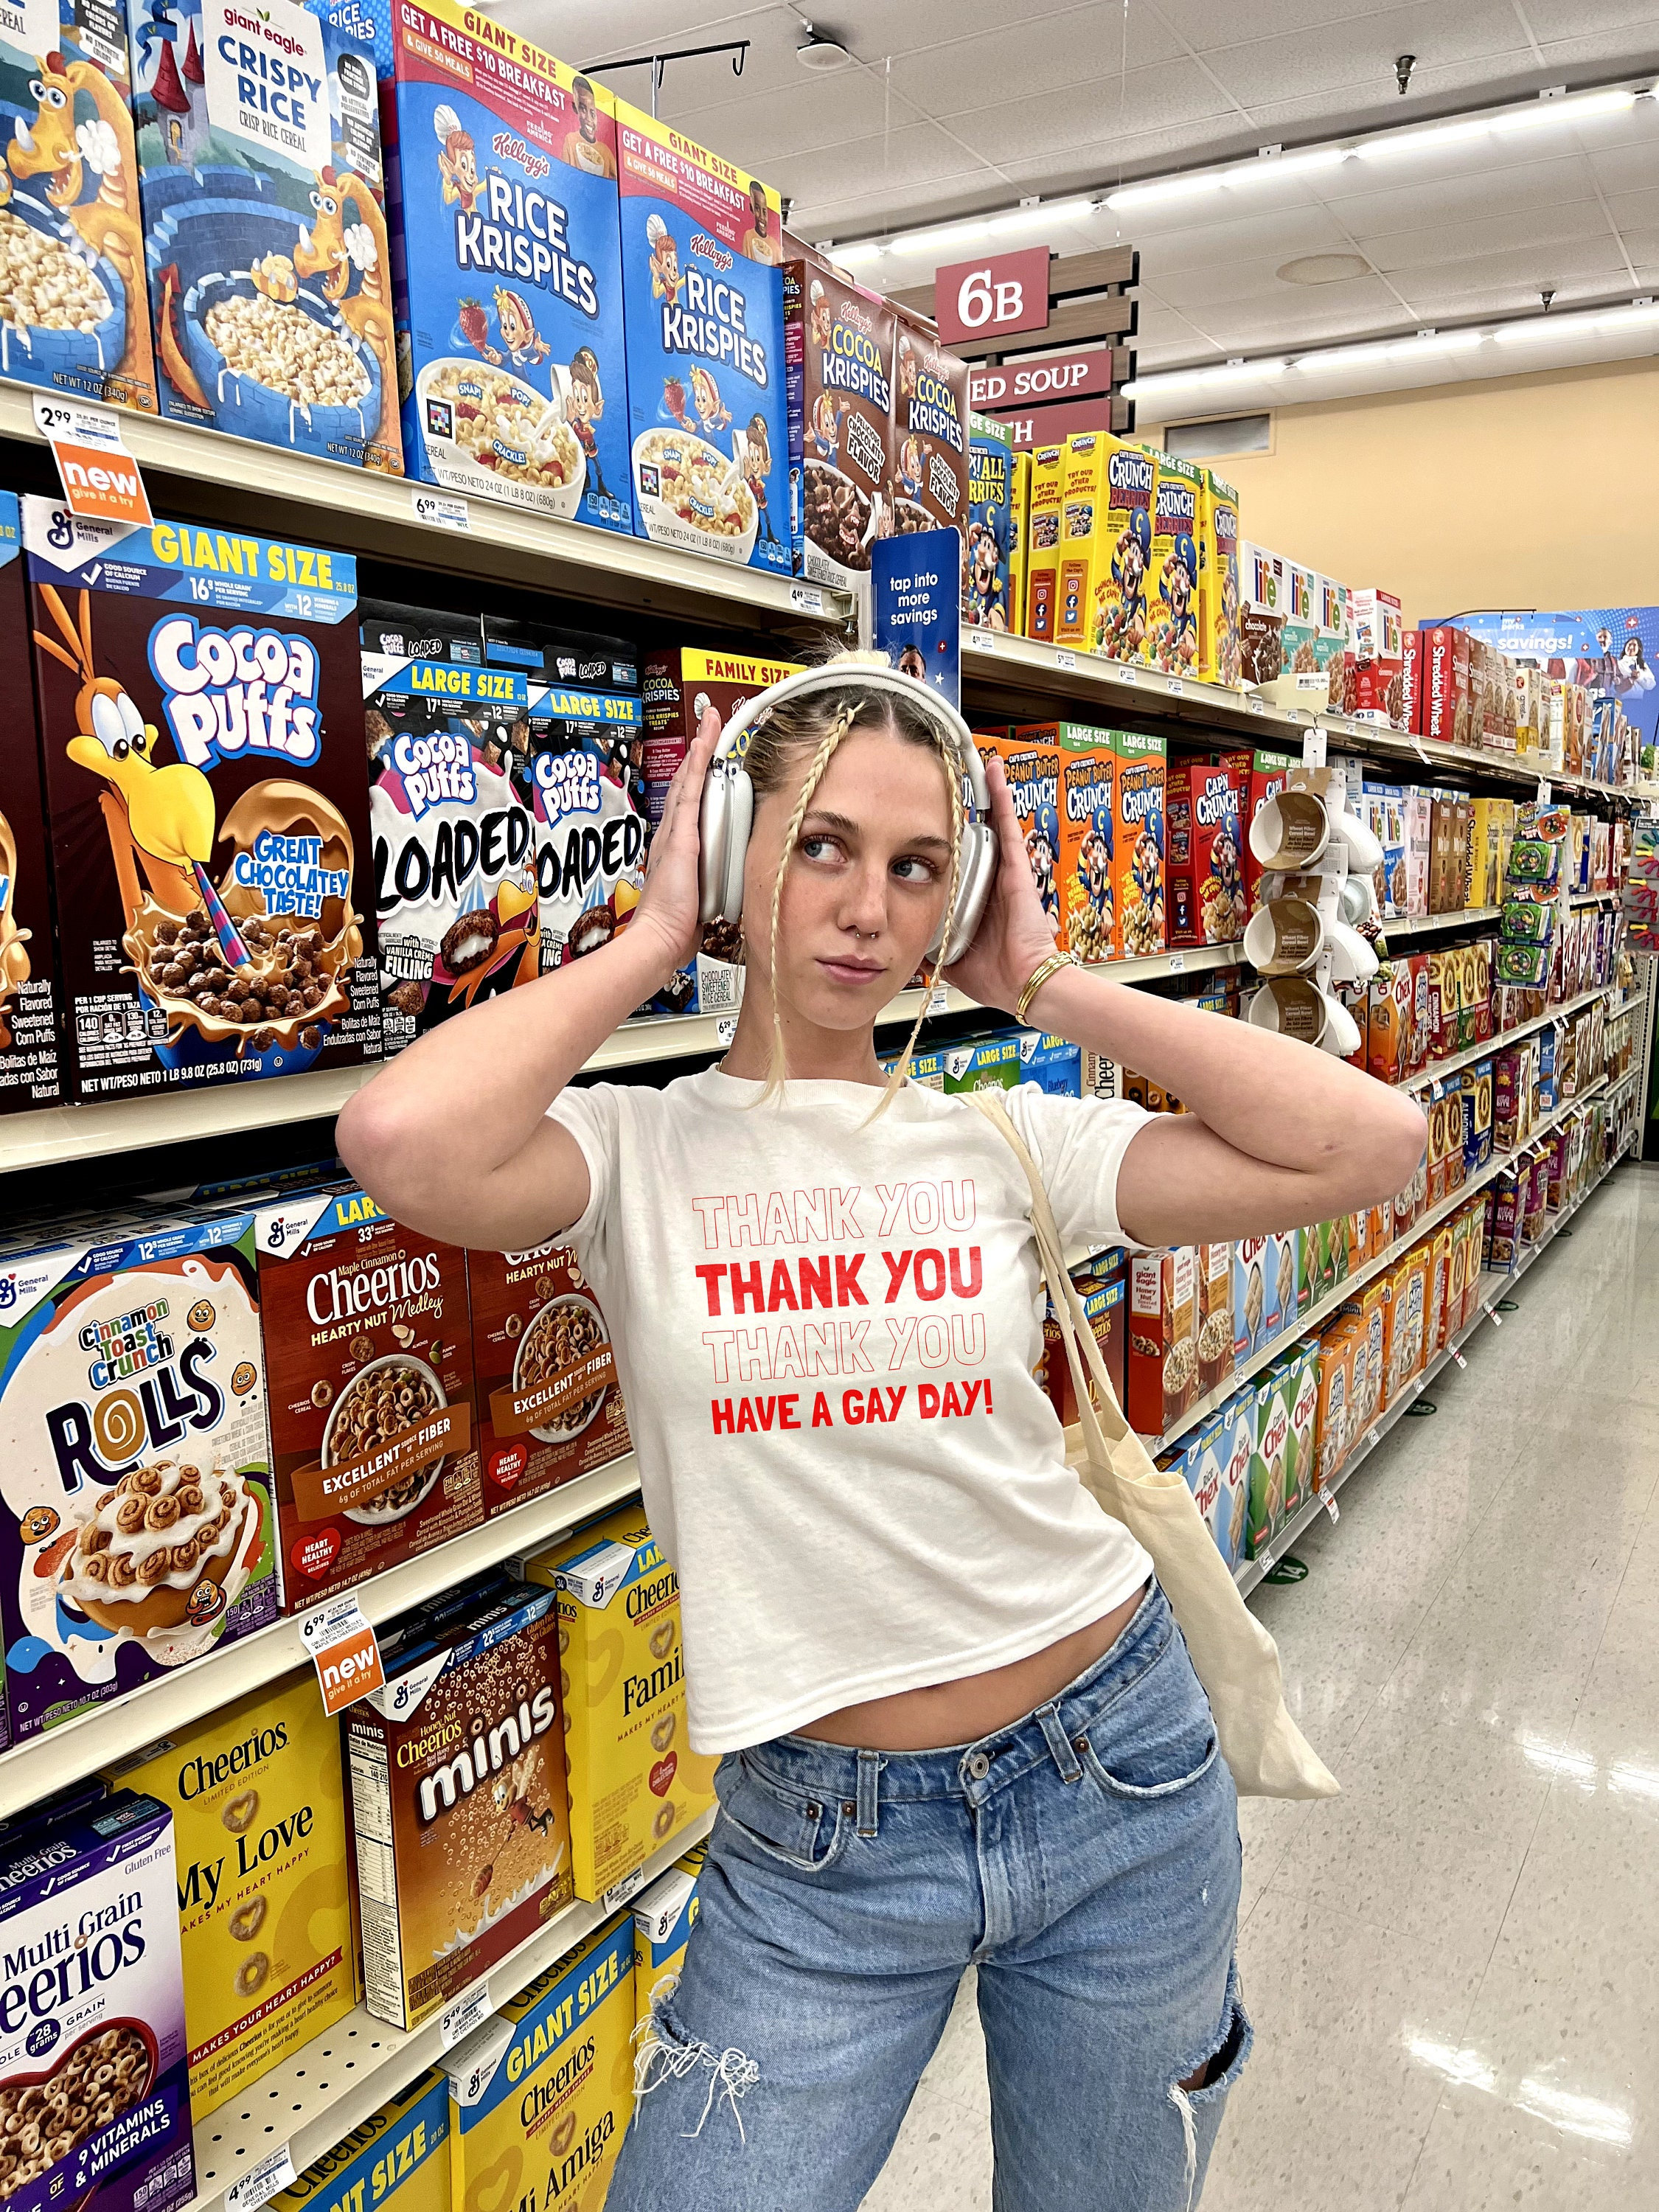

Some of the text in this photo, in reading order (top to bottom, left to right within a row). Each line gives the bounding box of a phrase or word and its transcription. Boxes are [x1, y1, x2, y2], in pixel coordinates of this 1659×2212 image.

[224, 8, 305, 56] giant eagle
[465, 11, 556, 79] GIANT SIZE
[218, 35, 321, 102] CRISPY
[401, 4, 425, 34] GET
[441, 26, 473, 60] FREE
[476, 46, 495, 72] $10
[498, 60, 565, 111] BREAKFAST
[445, 55, 470, 77] MEALS
[238, 74, 306, 130] RICE
[281, 129, 307, 153] CEREAL
[493, 133, 550, 179] Kellogg's
[696, 171, 745, 212] BREAKFAST
[490, 178, 567, 252] RICE
[456, 215, 599, 318] KRISPIES
[687, 272, 745, 332] RICE
[958, 269, 1023, 328] 6B
[663, 307, 768, 389] KRISPIES
[832, 324, 883, 375] COCOA
[53, 372, 68, 385] NET
[69, 377, 81, 388] WT
[83, 380, 92, 391] 12
[94, 383, 103, 394] OZ
[104, 386, 127, 403] (340g)
[823, 352, 890, 413] KRISPIES
[917, 375, 957, 421] COCOA
[1015, 365, 1088, 395] SOUP
[848, 416, 886, 467] CHOCOLATEY
[855, 411, 880, 448] DELICIOUS
[909, 406, 963, 453] KRISPIES
[847, 434, 880, 485] FLAVOR
[981, 458, 1005, 481] ALL
[1068, 471, 1079, 479] TRY
[1109, 453, 1153, 490] CRUNCH
[63, 462, 136, 497] new
[72, 487, 133, 508] give it a try
[930, 476, 957, 518] FLAVOR
[1071, 477, 1089, 487] OTHER
[1110, 488, 1150, 510] BERRIES
[75, 521, 113, 536] General
[77, 532, 98, 543] Mills
[151, 524, 333, 589] GIANT SIZE
[890, 571, 938, 592] tap into
[898, 592, 930, 608] more
[891, 608, 938, 626] savings
[154, 621, 314, 699] Cocoa
[1498, 635, 1573, 653] savings!
[411, 666, 514, 699] LARGE SIZE
[706, 658, 756, 679] FAMILY
[550, 693, 633, 721] LARGE SIZE
[1430, 646, 1445, 737] Shredded Wheat
[394, 734, 470, 776] Cocoa
[536, 753, 598, 789] Cocoa
[1093, 763, 1113, 782] BUTTER
[1121, 768, 1165, 792] PEANUT BUTTER
[1206, 773, 1228, 797] CAP'N
[1067, 782, 1112, 823] CRUNCH
[1121, 786, 1163, 824] CRUNCH
[1196, 789, 1239, 824] CRUNCH
[257, 832, 321, 865] GREAT
[375, 805, 529, 910] LOADED
[236, 855, 348, 897] CHOCOLATEY
[263, 890, 321, 918] TASTE!
[386, 947, 434, 961] VANILLA CRÈME
[404, 936, 419, 948] with
[386, 956, 432, 980] FILLING
[976, 1045, 1016, 1065] LARGE SIZE
[81, 1079, 98, 1093] NET
[101, 1074, 138, 1090] WT/PESO
[140, 1071, 161, 1084] NETO
[170, 1068, 180, 1080] LB
[181, 1065, 193, 1079] 9.8
[195, 1064, 204, 1077] OZ
[226, 1061, 239, 1074] OZ)
[240, 1058, 262, 1074] (731g)
[692, 1179, 976, 1249] THANK YOU
[18, 1275, 49, 1287] General
[307, 1253, 440, 1324] Cheerios
[338, 1264, 359, 1276] Maple
[506, 1263, 543, 1284] HEARTY
[695, 1246, 982, 1316] THANK YOU
[1136, 1270, 1156, 1280] giant
[19, 1286, 37, 1295] Mills
[1136, 1287, 1156, 1295] Honey
[311, 1292, 443, 1346] HEARTY Medley
[702, 1313, 986, 1383] THANK YOU
[514, 1351, 611, 1414] EXCELLENT FIBER
[45, 1340, 221, 1492] ROLLS
[711, 1379, 992, 1435] HAVE A GAY DAY!
[1294, 1390, 1315, 1428] Chex
[322, 1417, 451, 1495] EXCELLENT FIBER
[416, 1441, 443, 1463] SERVING
[1265, 1417, 1287, 1459] Chex
[498, 1453, 517, 1465] HEART
[1230, 1444, 1250, 1485] Chex
[305, 1538, 328, 1553] HEART
[1278, 1565, 1306, 1579] 14
[322, 1644, 374, 1689] new
[178, 1720, 288, 1800] Cheerios
[397, 1719, 462, 1768] Cheerios
[420, 1686, 555, 1821] minis
[204, 1763, 270, 1806] LIMITED EDITION
[235, 1804, 313, 1878] Love
[125, 1852, 153, 1875] Gluten
[237, 1847, 310, 1902] HEART HAPPY
[5, 1891, 143, 1981] Multi Grain
[66, 1999, 105, 2025] GRAIN
[192, 2033, 229, 2063] MAKES
[233, 2010, 261, 2034] YOUR
[265, 1983, 297, 2013] HEART
[301, 1956, 335, 1988] HAPPY?
[507, 1955, 619, 2083] GIANT SIZE
[30, 2031, 58, 2054] grams
[217, 2032, 262, 2067] delicious Cheerios
[521, 2034, 597, 2128] Cheerios
[75, 2114, 170, 2188] & MINERALS
[80, 2099, 164, 2166] 9 VITAMINS
[545, 2110, 615, 2198] Amiga
[49, 2178, 63, 2193] OF
[243, 2180, 279, 2207] GENERAL MILLS
[251, 2189, 276, 2206] CHEERIOS
